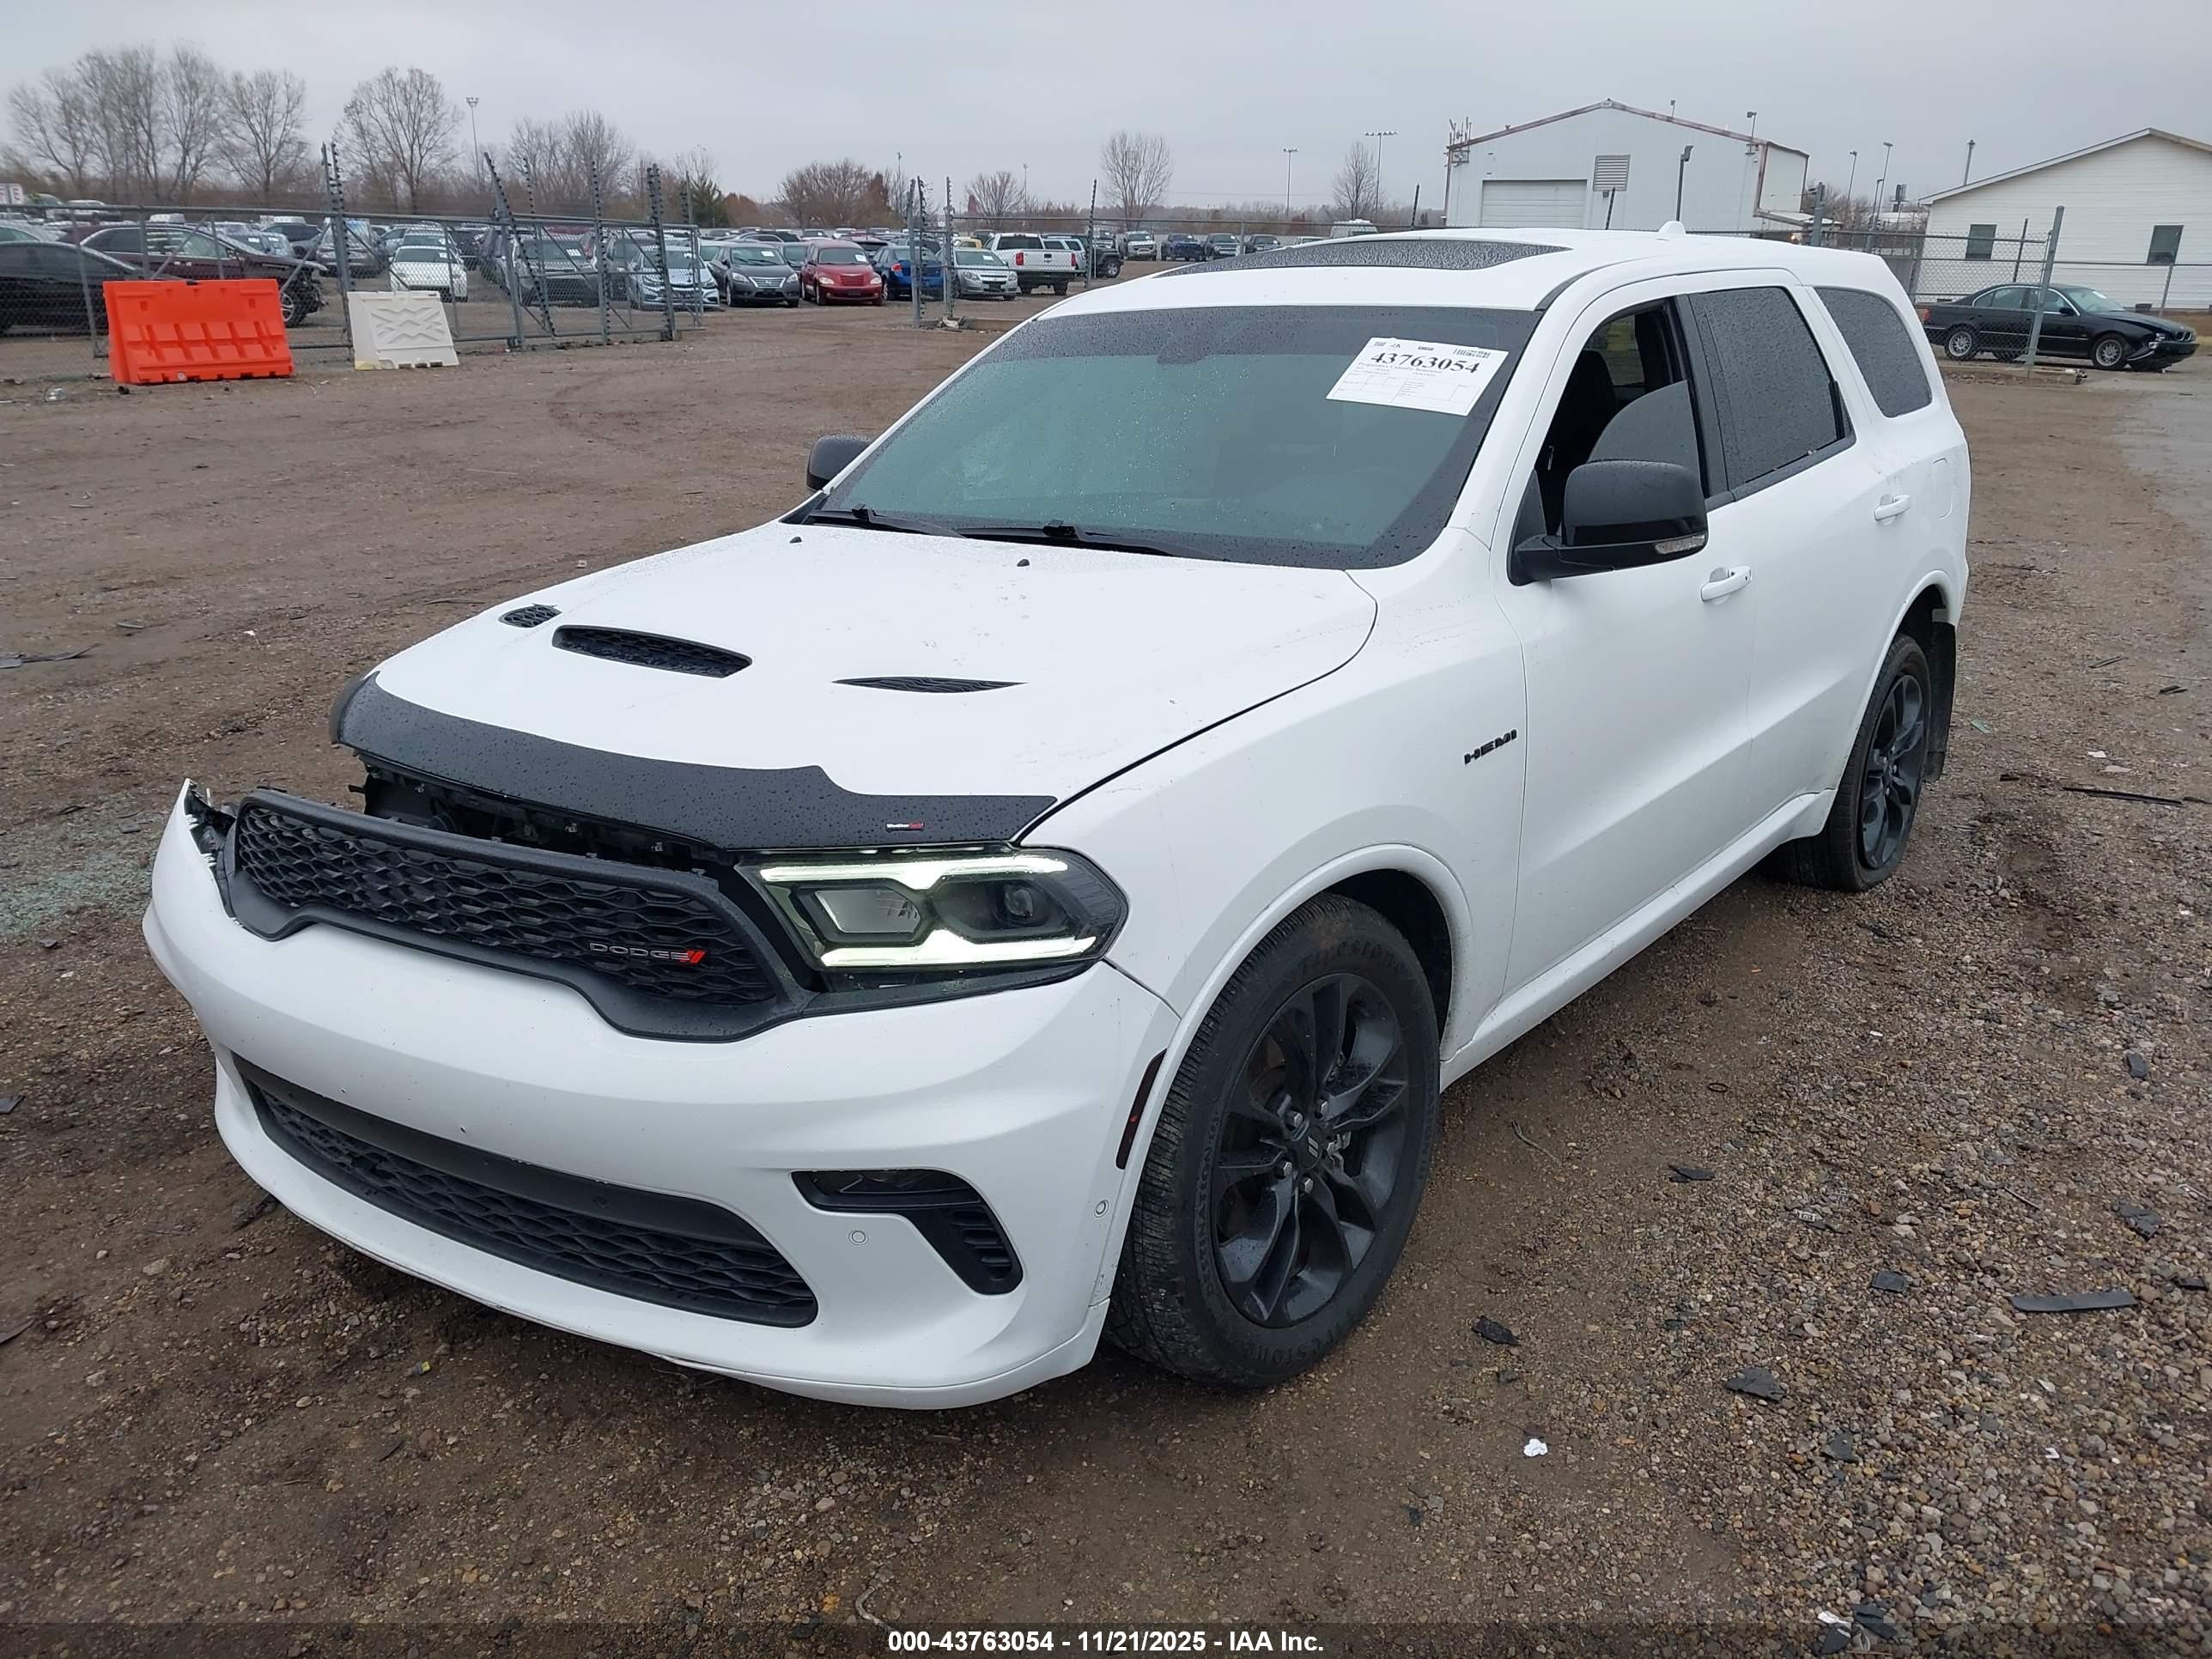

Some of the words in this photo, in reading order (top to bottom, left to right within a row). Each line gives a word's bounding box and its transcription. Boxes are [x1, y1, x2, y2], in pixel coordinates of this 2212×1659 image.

[1370, 352, 1480, 374] 43763054
[1464, 728, 1517, 765] HEMI
[589, 942, 690, 961] DODGE
